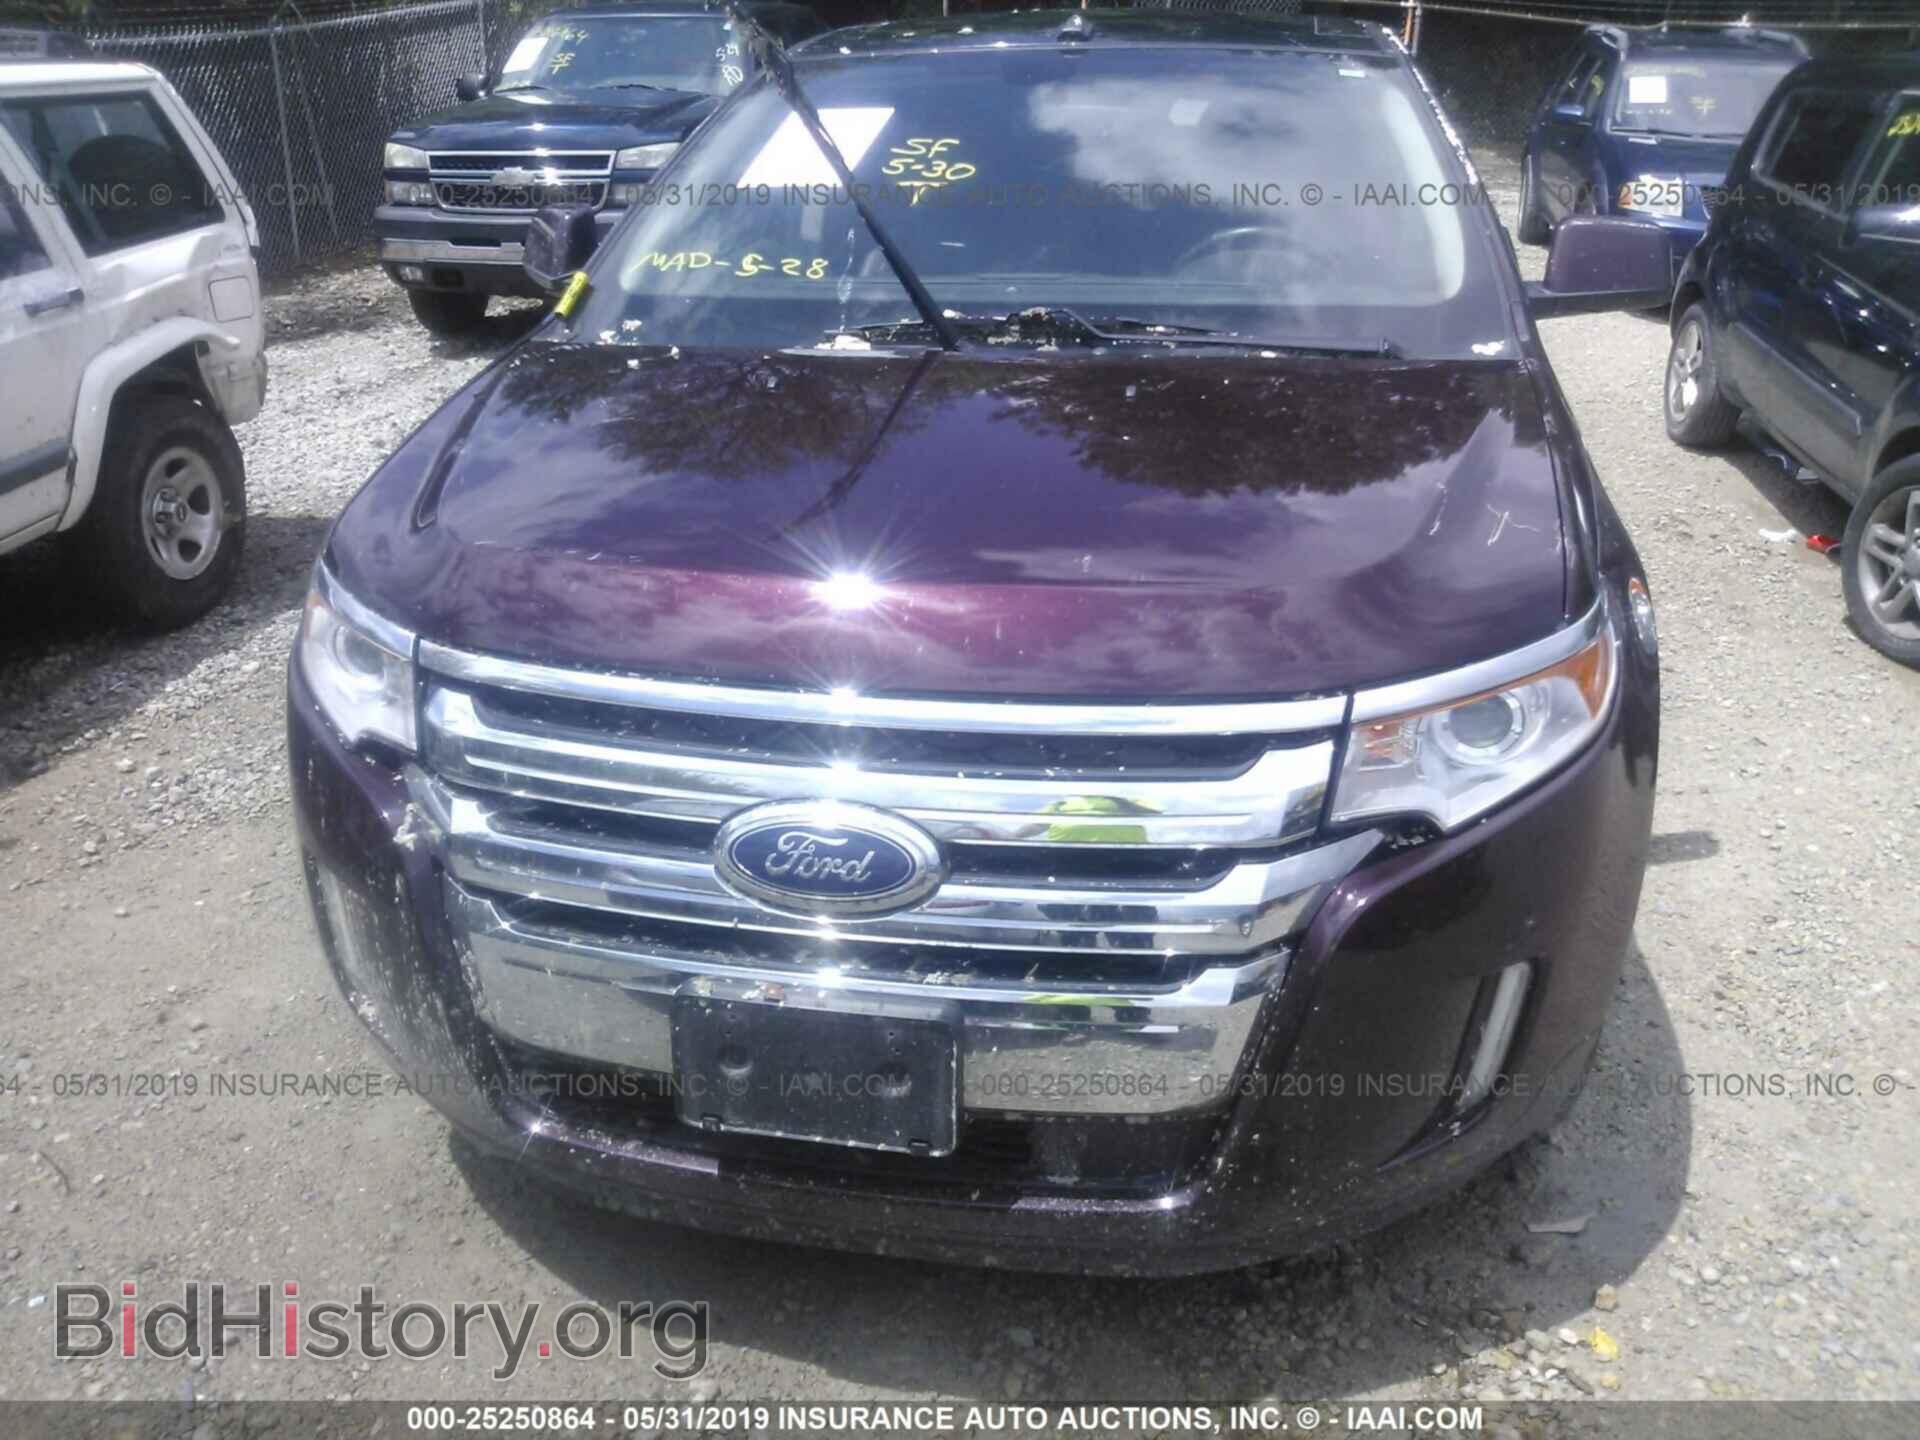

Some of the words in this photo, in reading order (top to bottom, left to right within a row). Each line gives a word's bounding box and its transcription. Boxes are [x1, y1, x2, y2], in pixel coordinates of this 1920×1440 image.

[890, 138, 960, 159] SF
[881, 158, 976, 181] 5-30
[764, 830, 876, 883] Ford
